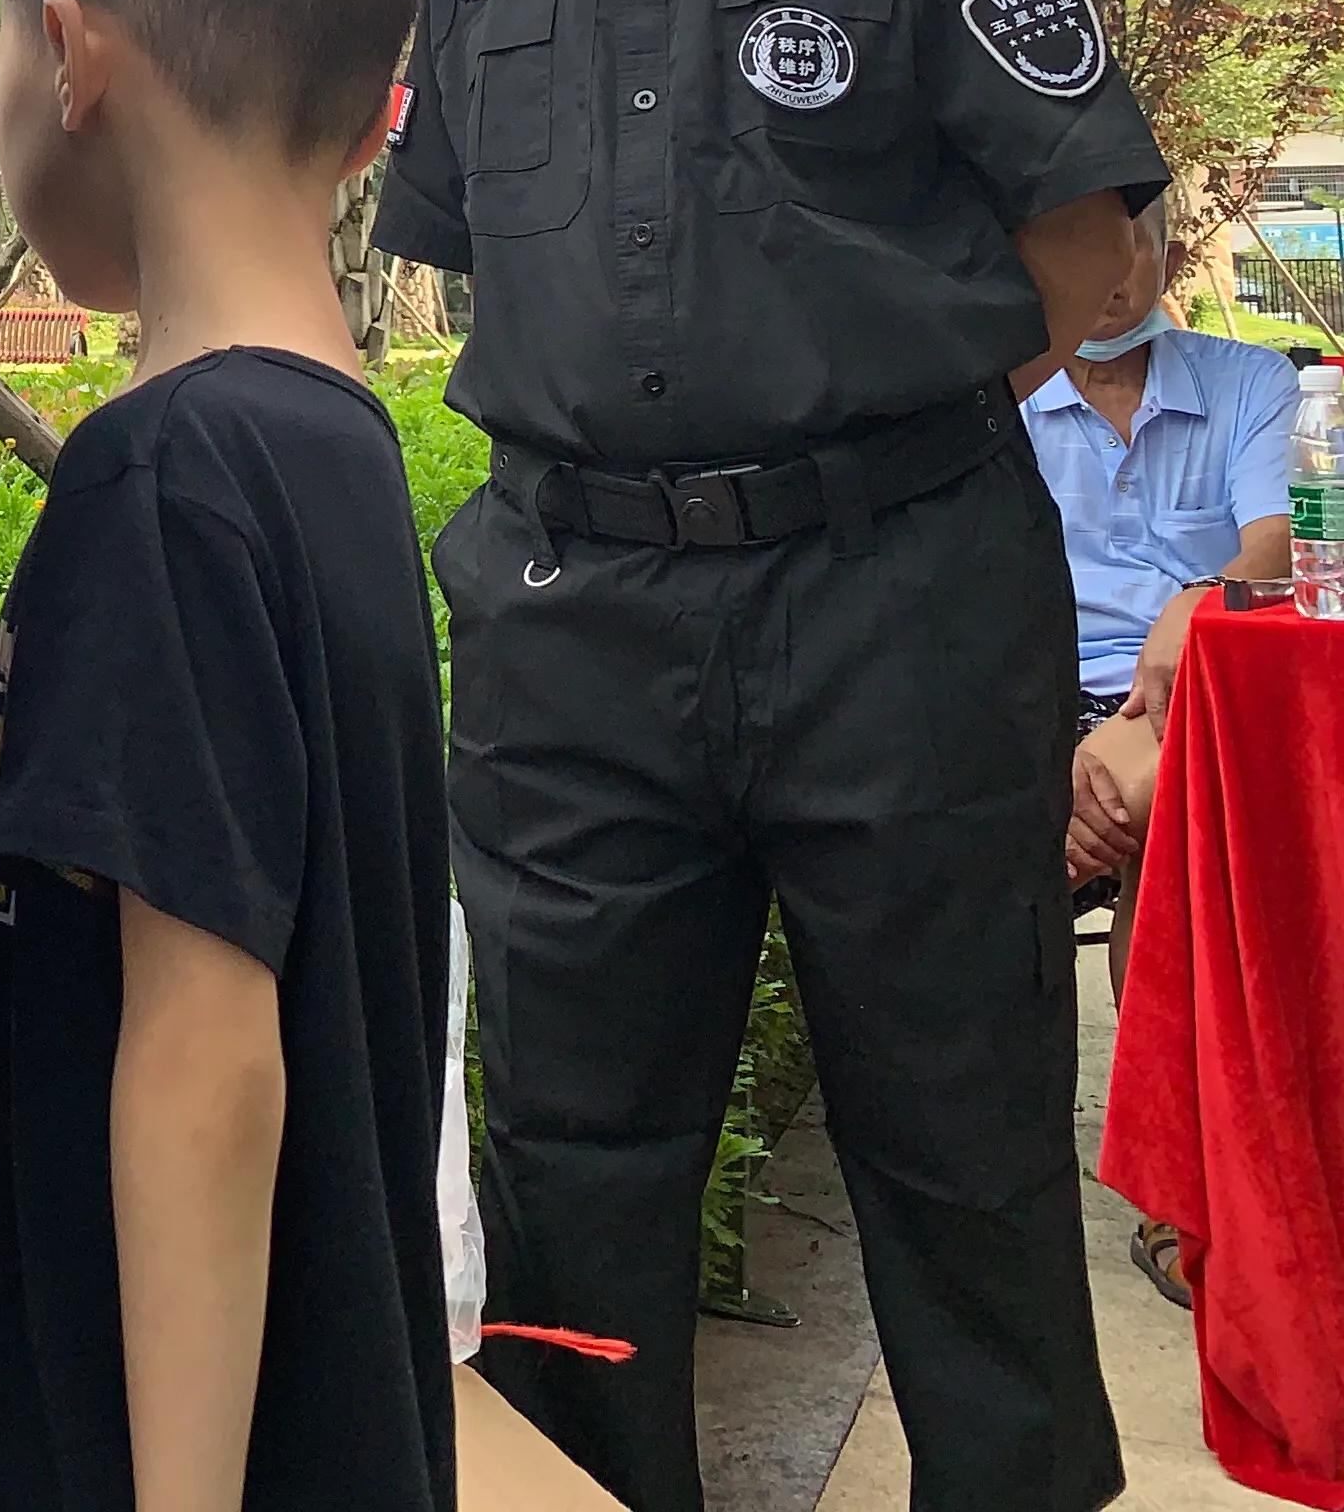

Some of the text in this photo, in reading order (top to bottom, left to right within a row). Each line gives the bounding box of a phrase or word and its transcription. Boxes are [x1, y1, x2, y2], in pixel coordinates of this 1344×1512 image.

[777, 36, 816, 57] 秩序
[778, 57, 816, 77] 维护
[764, 84, 830, 106] ZHIXUWEIHU
